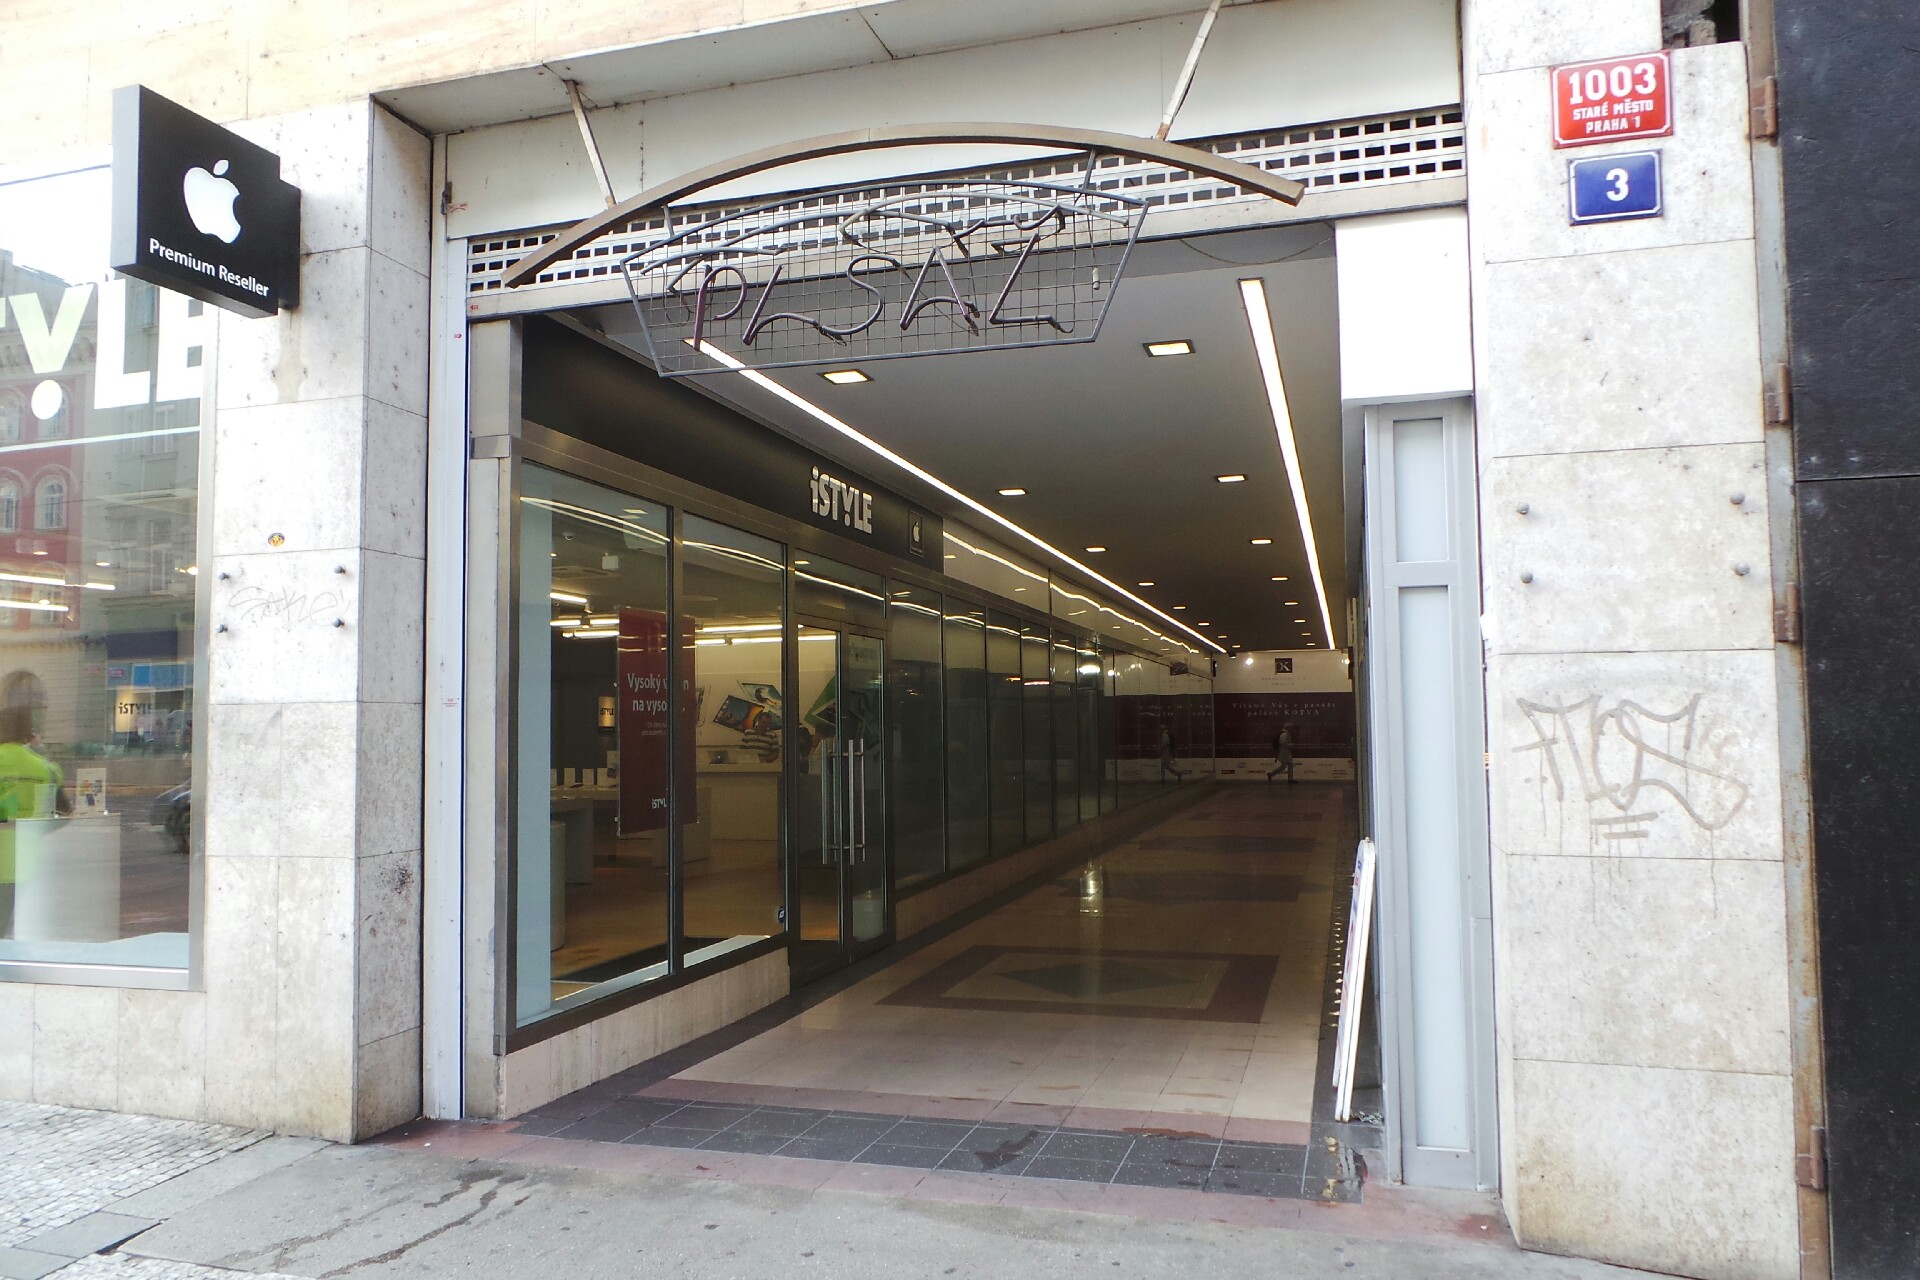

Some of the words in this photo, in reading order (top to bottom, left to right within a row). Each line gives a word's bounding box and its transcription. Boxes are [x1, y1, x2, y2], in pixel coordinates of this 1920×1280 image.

[1569, 62, 1657, 105] 1003
[1573, 102, 1609, 120] STARÉ
[1613, 98, 1654, 115] MĚSTO
[1585, 117, 1629, 134] PRAHA
[1633, 115, 1641, 128] 1
[1605, 168, 1630, 202] 3
[149, 237, 216, 277] Premium
[218, 264, 270, 297] Reseller
[810, 465, 873, 535] iSTYLE
[627, 672, 661, 693] Vysoký
[632, 699, 645, 712] na
